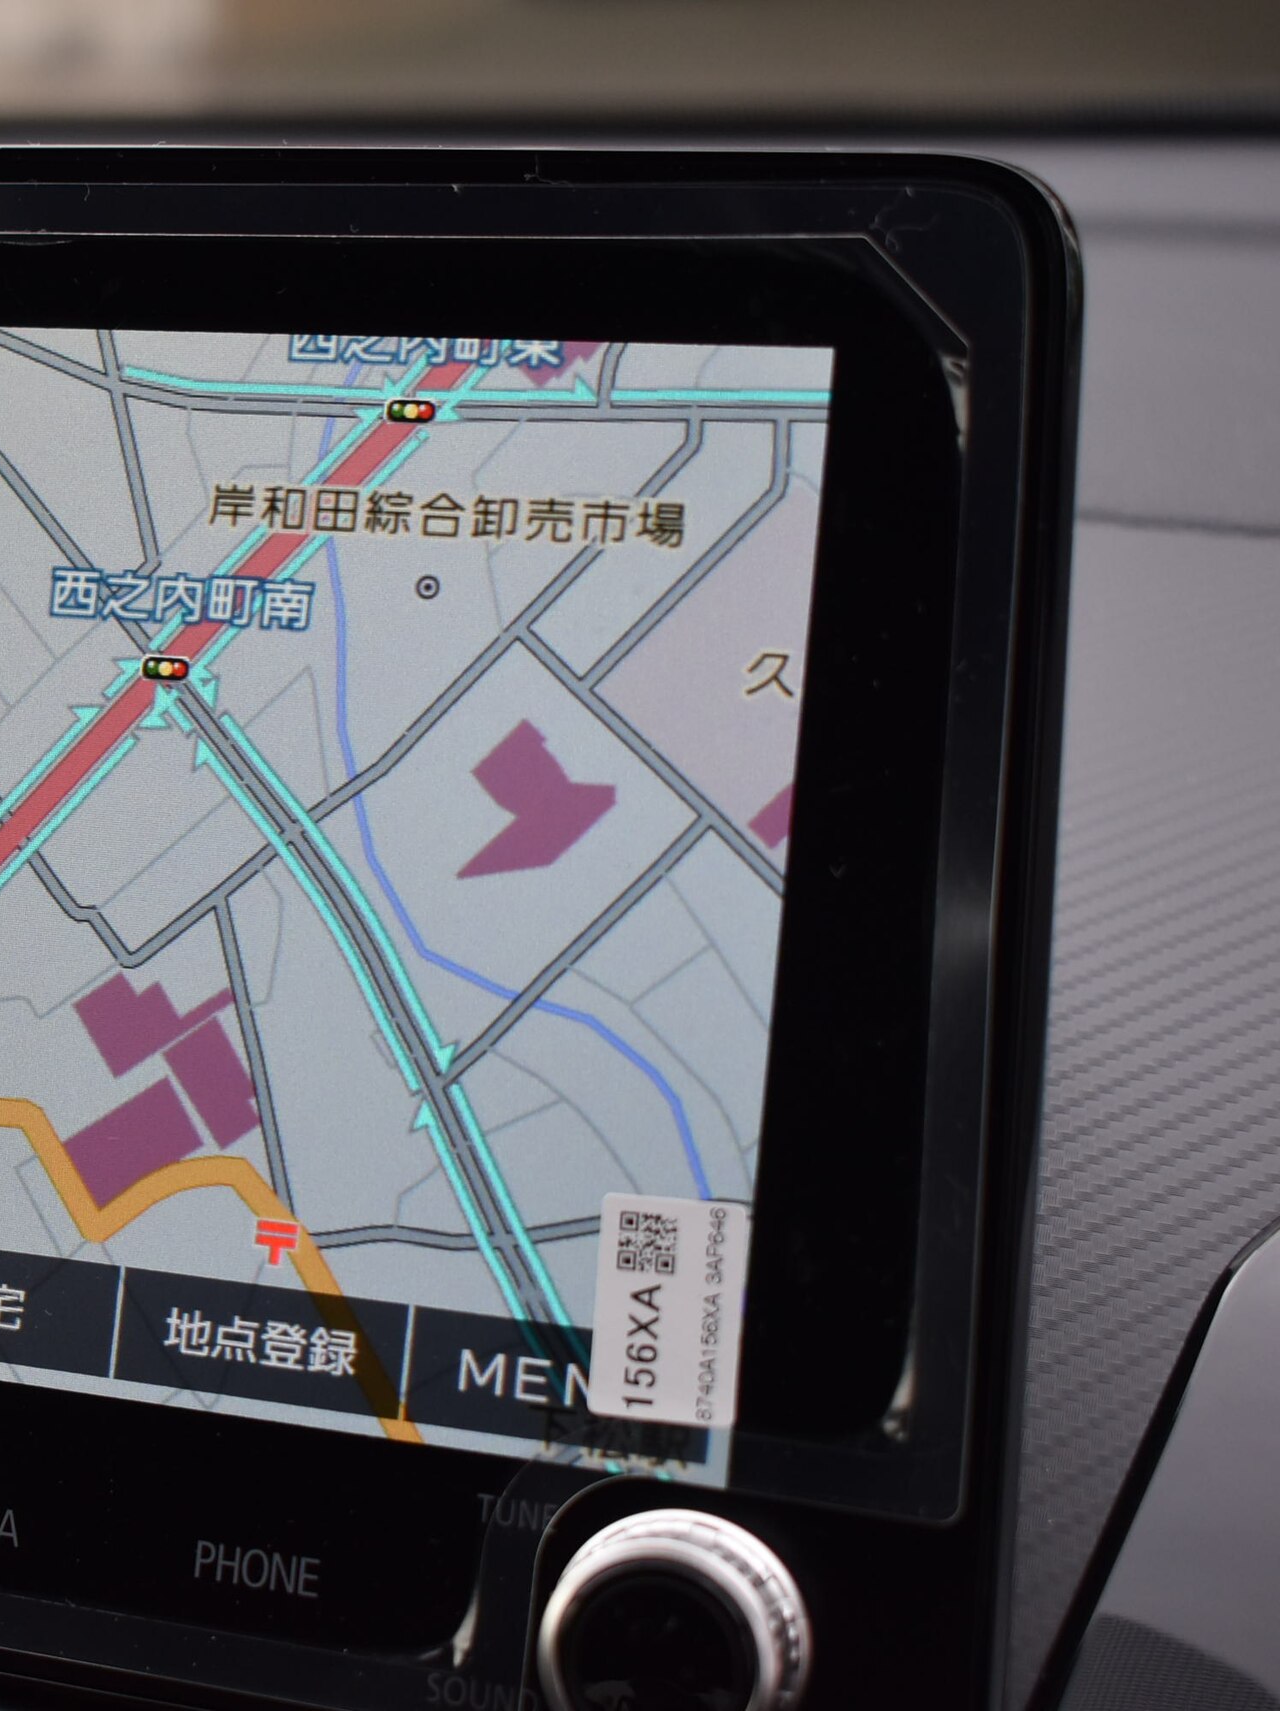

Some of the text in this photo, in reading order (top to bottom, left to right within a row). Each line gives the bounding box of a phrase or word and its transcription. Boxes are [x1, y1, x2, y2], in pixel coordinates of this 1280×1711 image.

[209, 484, 686, 549] 岸和田綜合卸売市場
[50, 567, 315, 630] 西之内町南
[745, 652, 795, 699] 久
[164, 1307, 359, 1378] 地点登録
[623, 1283, 664, 1410] 156XA
[457, 1348, 589, 1408] MEN
[476, 1492, 558, 1533] TUNE
[194, 1540, 320, 1598] PHONE
